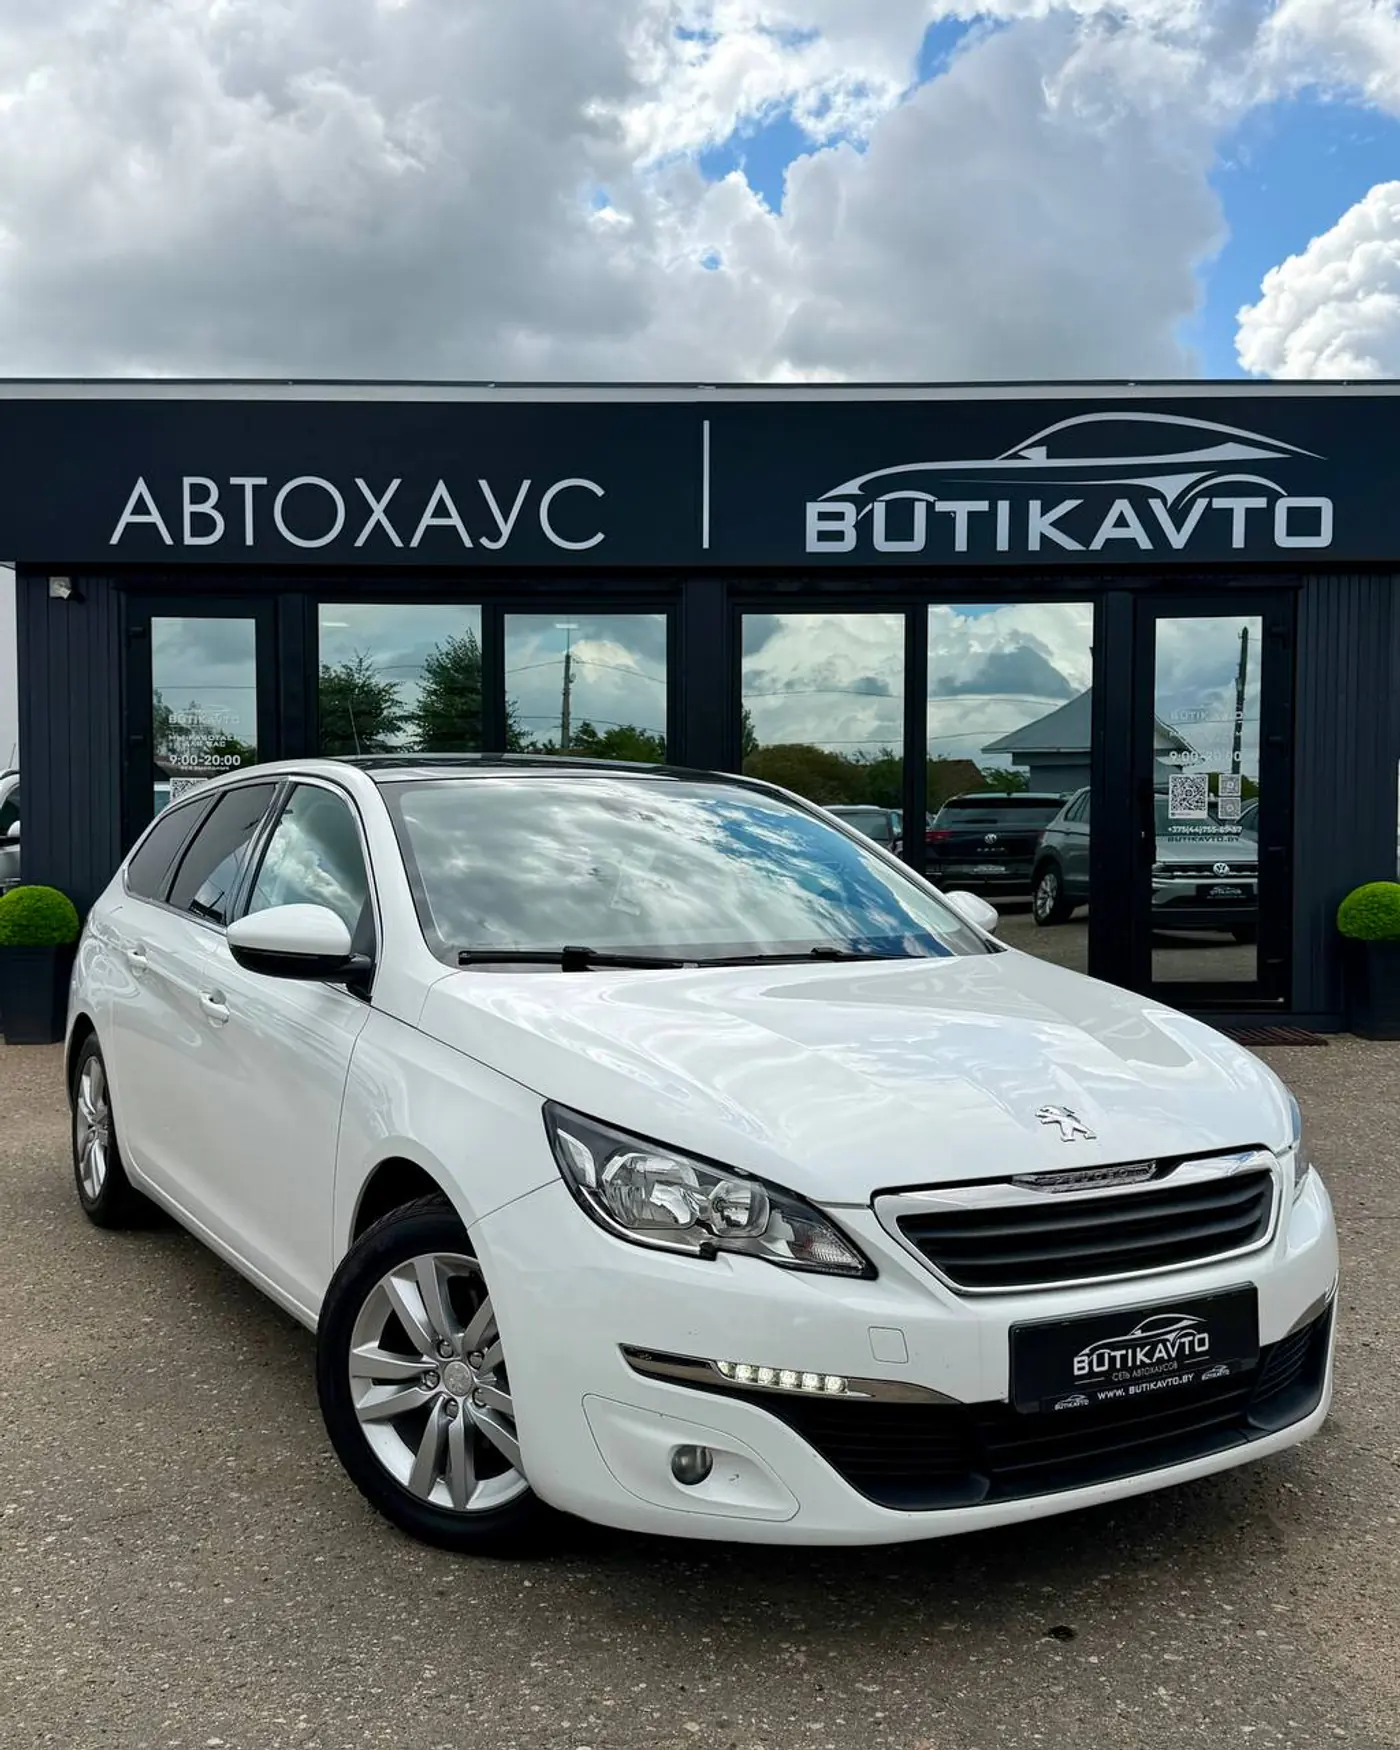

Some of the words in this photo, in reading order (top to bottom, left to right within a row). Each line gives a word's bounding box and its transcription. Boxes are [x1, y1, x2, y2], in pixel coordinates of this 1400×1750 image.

[109, 475, 606, 551] АВТОХАУС
[805, 496, 1334, 553] BUTIKAVTO
[169, 754, 241, 766] 9:00-20:00
[1073, 1333, 1210, 1376] BUTIKAVTO
[1129, 1372, 1195, 1394] BUTIKAVTO.BY
